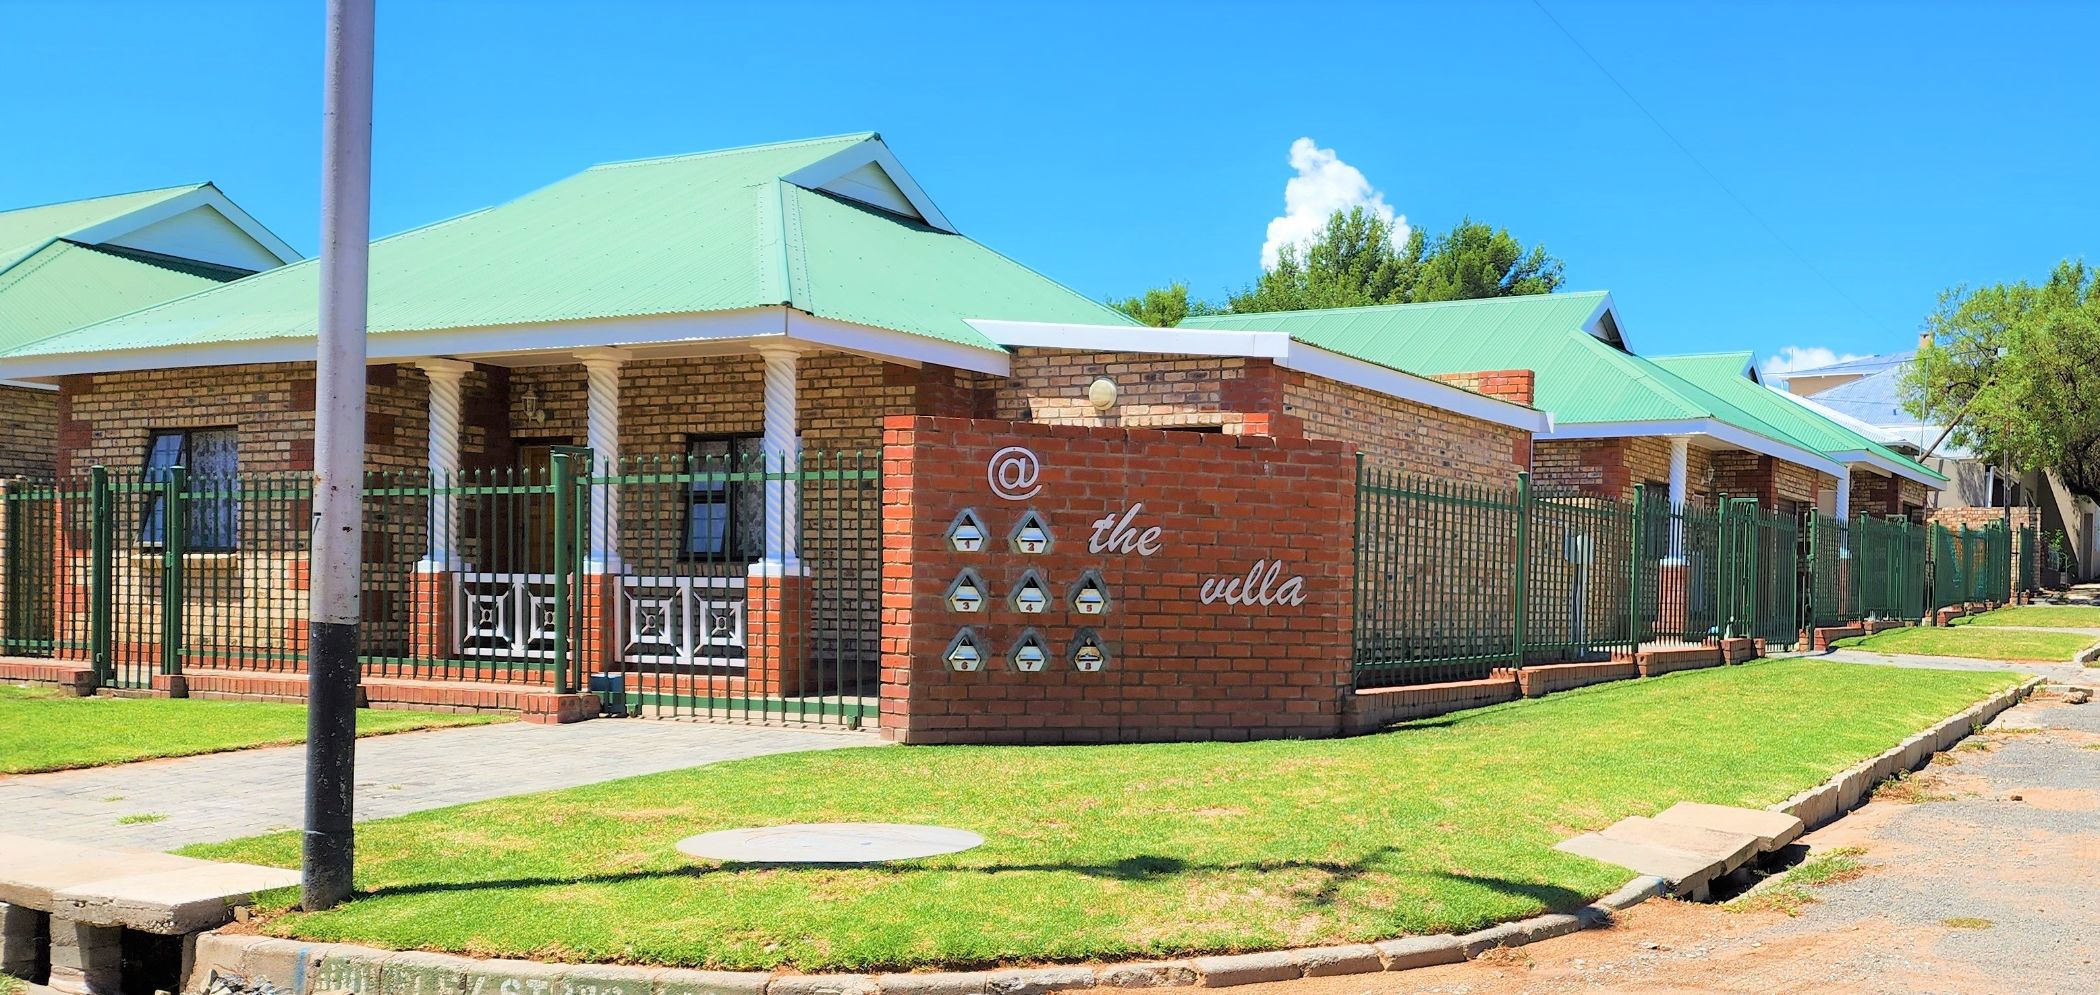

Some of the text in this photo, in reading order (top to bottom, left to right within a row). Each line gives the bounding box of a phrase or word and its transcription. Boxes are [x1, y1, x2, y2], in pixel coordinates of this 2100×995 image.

[988, 446, 1042, 501] @
[1088, 502, 1162, 556] the
[964, 541, 971, 549] 1
[1028, 543, 1035, 551] 2
[1199, 559, 1308, 607] villa
[962, 602, 970, 610] 3
[1026, 604, 1033, 612] 4
[961, 662, 968, 670] 6
[1026, 662, 1033, 670] 7
[1084, 662, 1092, 670] 8
